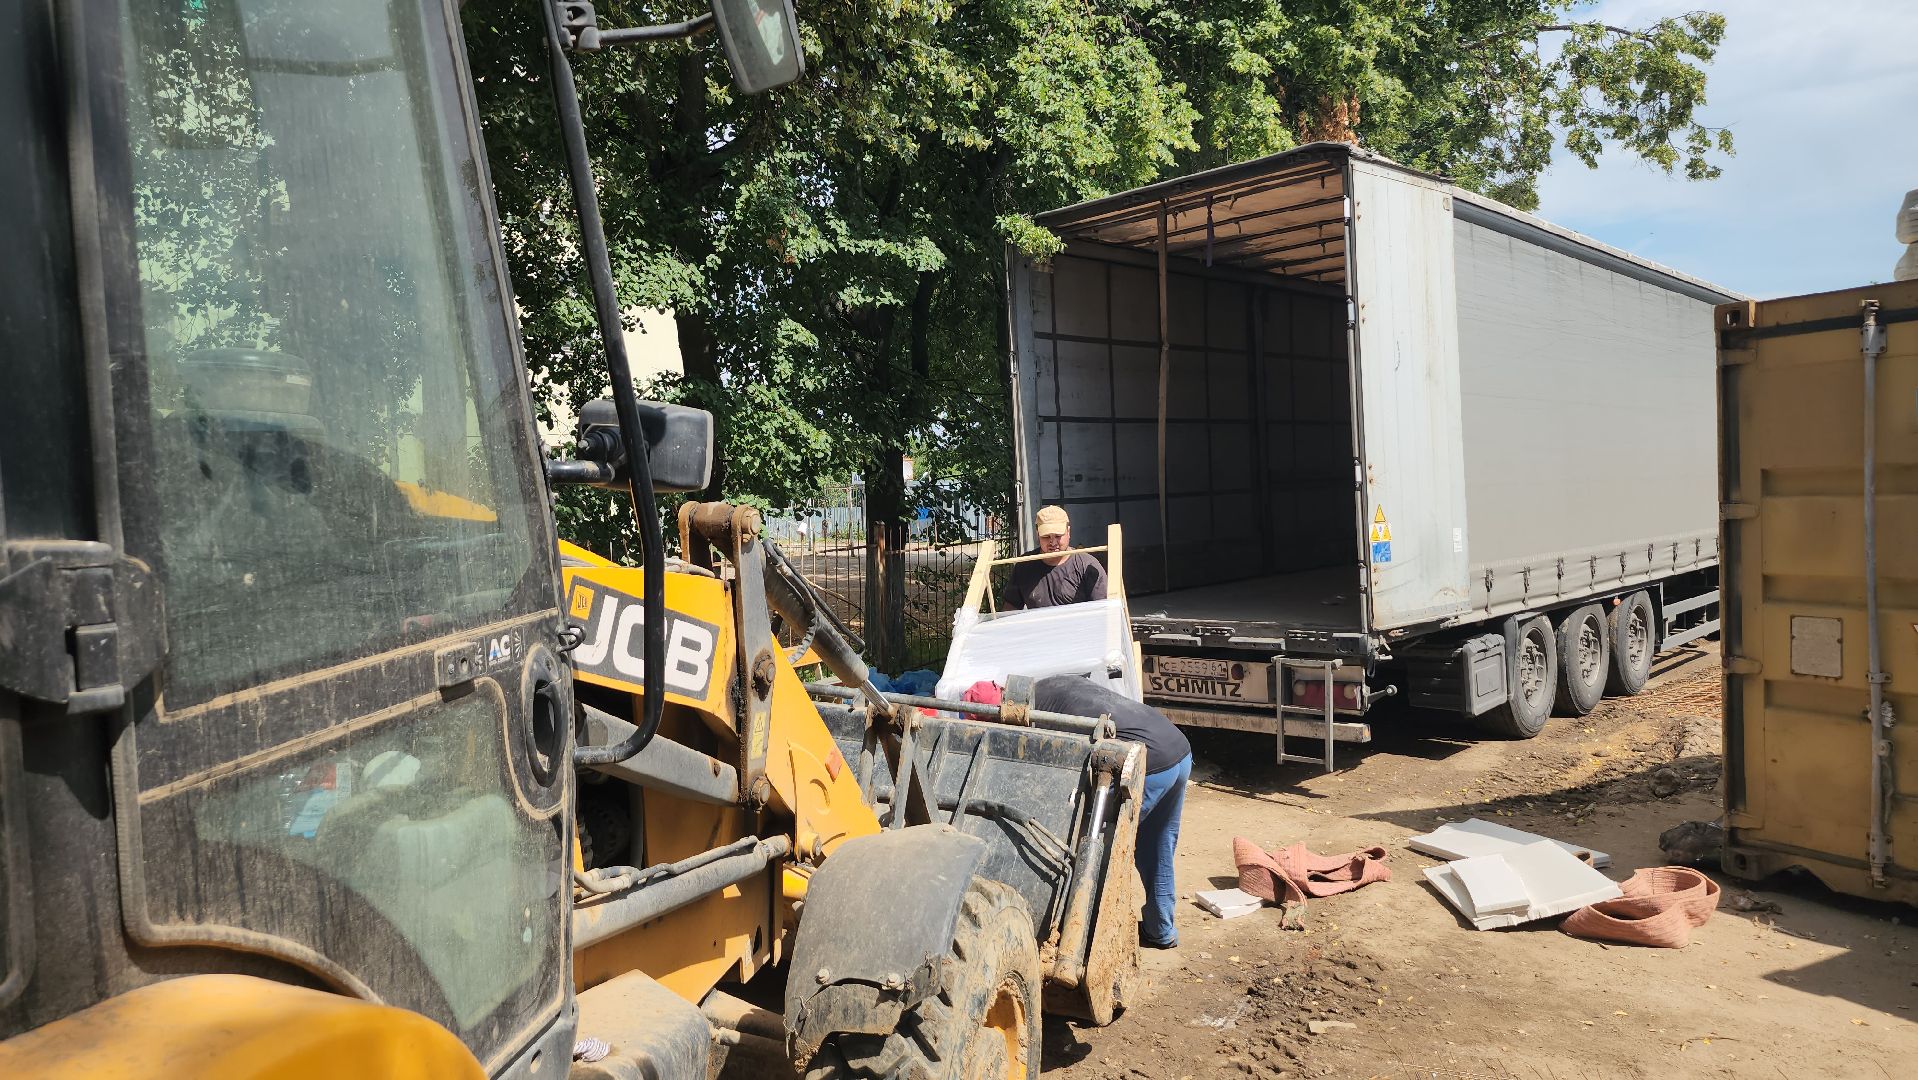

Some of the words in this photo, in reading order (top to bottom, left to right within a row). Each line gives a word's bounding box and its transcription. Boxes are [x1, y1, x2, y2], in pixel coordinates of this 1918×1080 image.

[488, 634, 511, 661] AC
[571, 594, 713, 692] JCB
[1151, 676, 1242, 697] SCHMITZ
